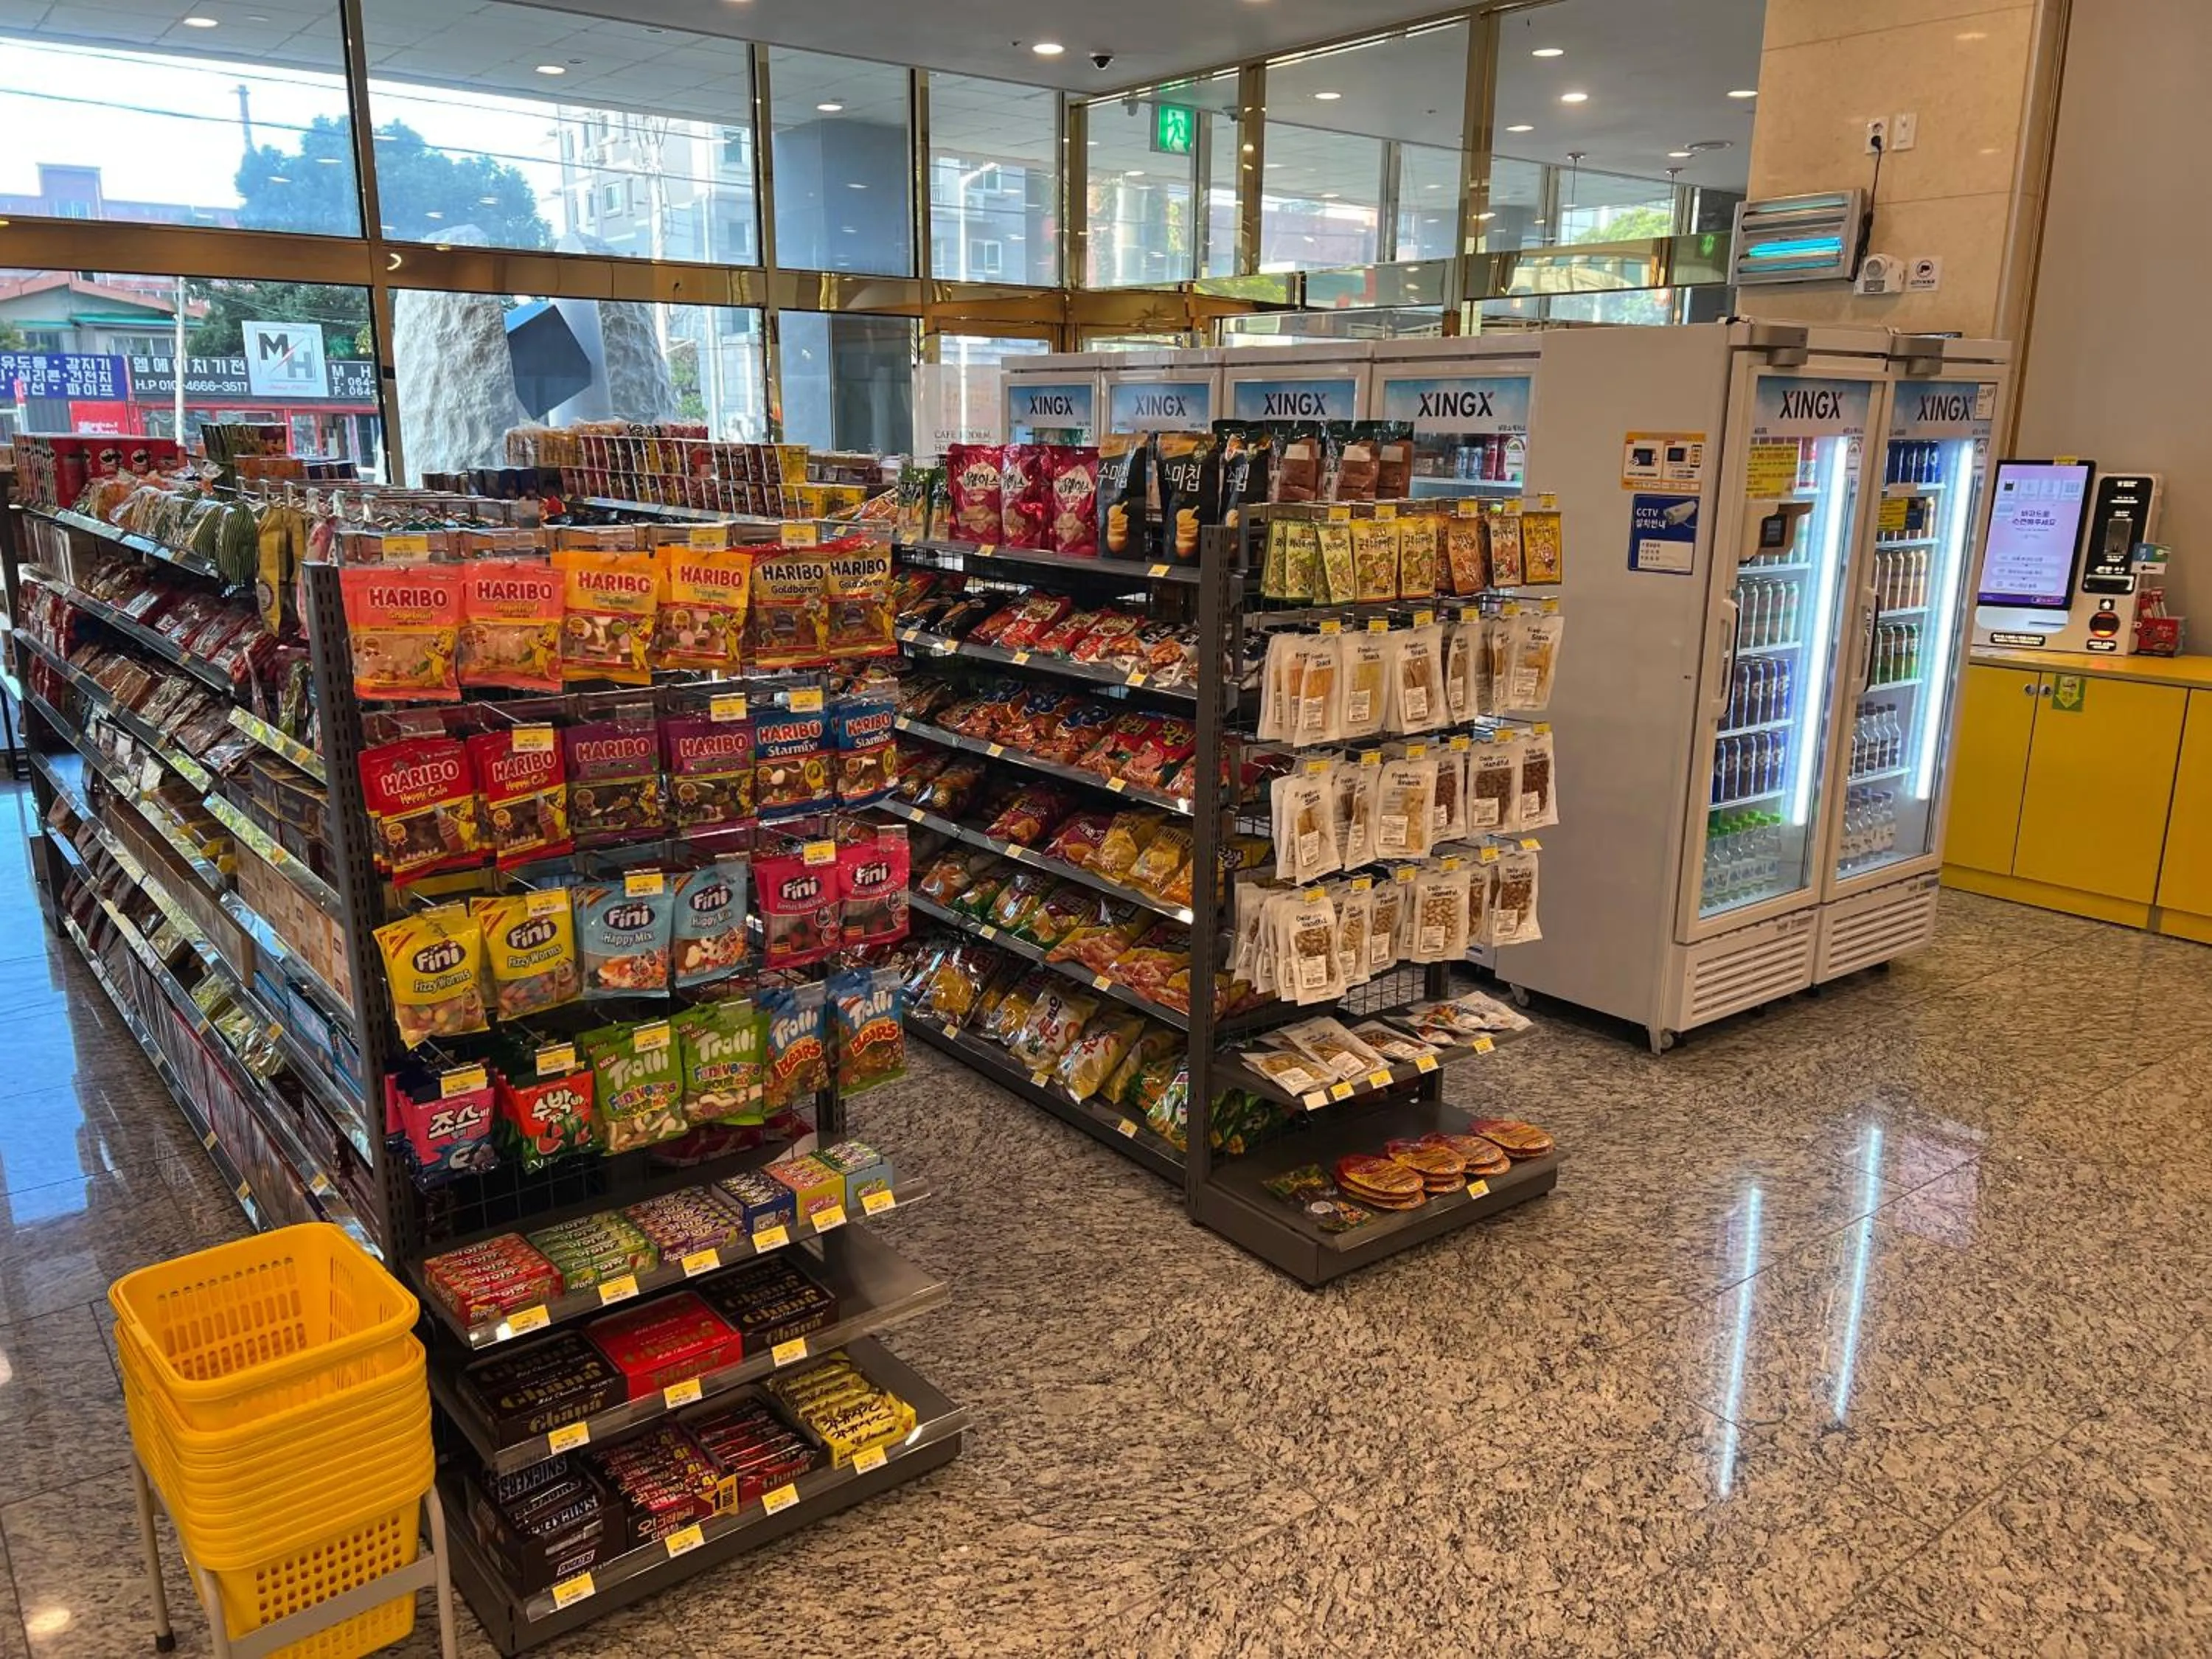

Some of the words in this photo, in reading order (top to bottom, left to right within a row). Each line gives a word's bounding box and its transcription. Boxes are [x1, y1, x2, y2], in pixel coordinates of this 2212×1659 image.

[259, 333, 290, 361] M
[288, 351, 313, 378] H
[332, 365, 344, 378] M
[361, 366, 371, 378] H
[66, 384, 115, 396] 파이프
[135, 379, 156, 391] H.P
[1030, 395, 1074, 415] XINGX
[1135, 395, 1186, 416] XINGX
[1264, 392, 1326, 415] XINGX
[1419, 392, 1494, 417] XINGX
[1780, 391, 1843, 419] XINGX
[1917, 395, 1974, 421] XINGX
[1636, 508, 1658, 517] CCTV
[681, 566, 742, 588] HARIBO
[762, 564, 824, 580] HARIBO
[830, 558, 886, 575] HARIBO
[477, 581, 552, 600] HARIBO
[577, 571, 651, 593] HARIBO
[369, 588, 448, 608] HARIBO
[757, 720, 823, 743] HARIBO
[846, 711, 891, 737] HARIBO
[577, 737, 651, 762] HARIBO
[680, 734, 748, 757] HARIBO
[767, 742, 817, 757] Starmix
[380, 759, 459, 796] HARIBO
[492, 751, 556, 782] HARIBO
[856, 863, 888, 885] Fini
[693, 886, 730, 911] Fini
[782, 877, 817, 900] Fini
[607, 905, 653, 929] Fini
[509, 919, 554, 947] Fini
[602, 933, 633, 947] Happy
[633, 931, 654, 942] Mix
[417, 943, 461, 973] Fini
[849, 991, 893, 1027] Trolli
[773, 1011, 818, 1048] Trolli
[696, 1026, 757, 1062] Trolli
[608, 1046, 669, 1091] Trolli
[532, 1089, 585, 1119] 수박바
